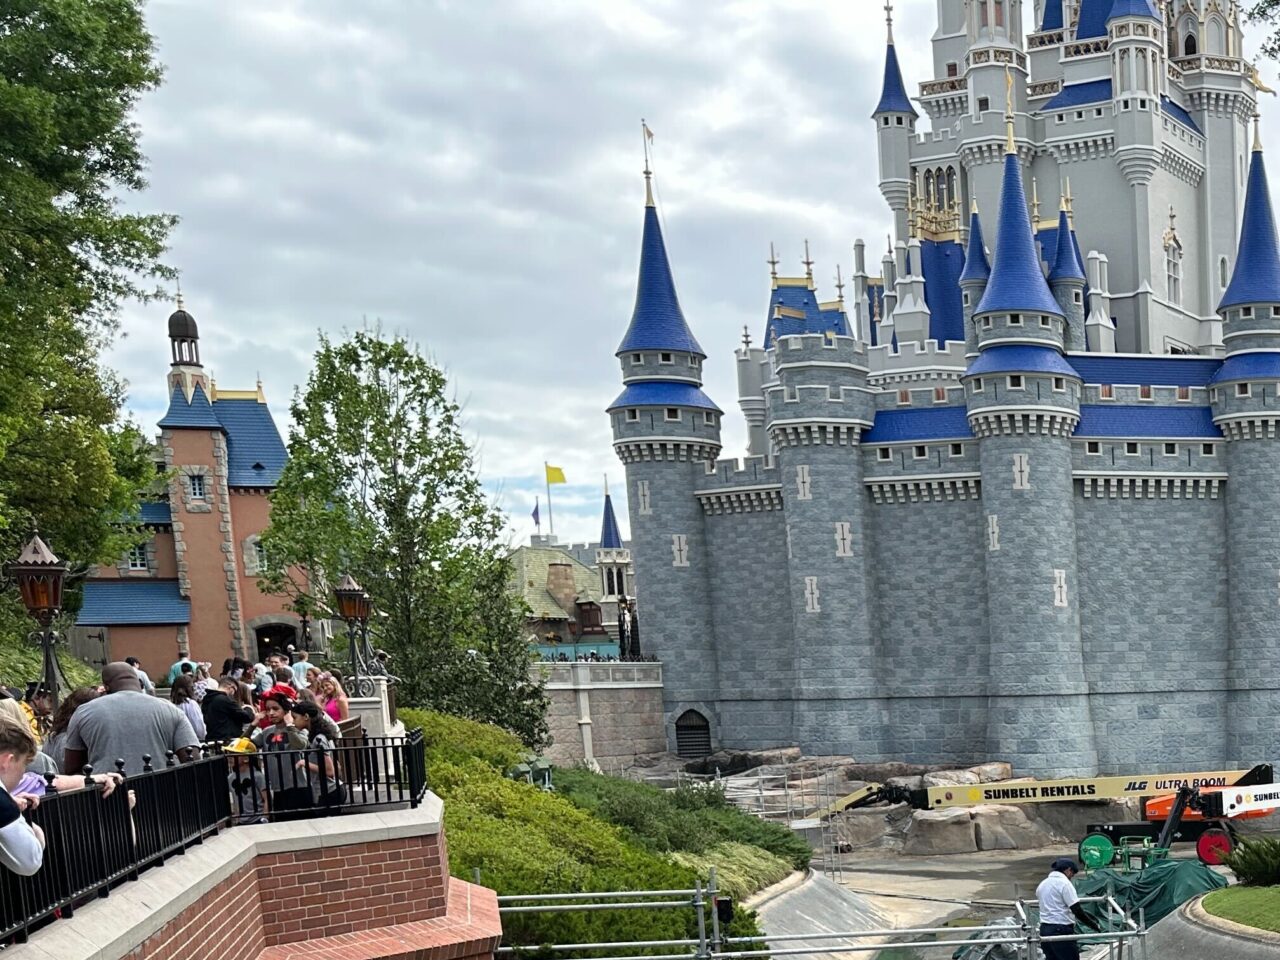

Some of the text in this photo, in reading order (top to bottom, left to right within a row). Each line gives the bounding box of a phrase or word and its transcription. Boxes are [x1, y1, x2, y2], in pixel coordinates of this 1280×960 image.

[1124, 777, 1226, 791] JLG ULTRA BOOM
[984, 784, 1096, 800] SUNBELT RENTALS
